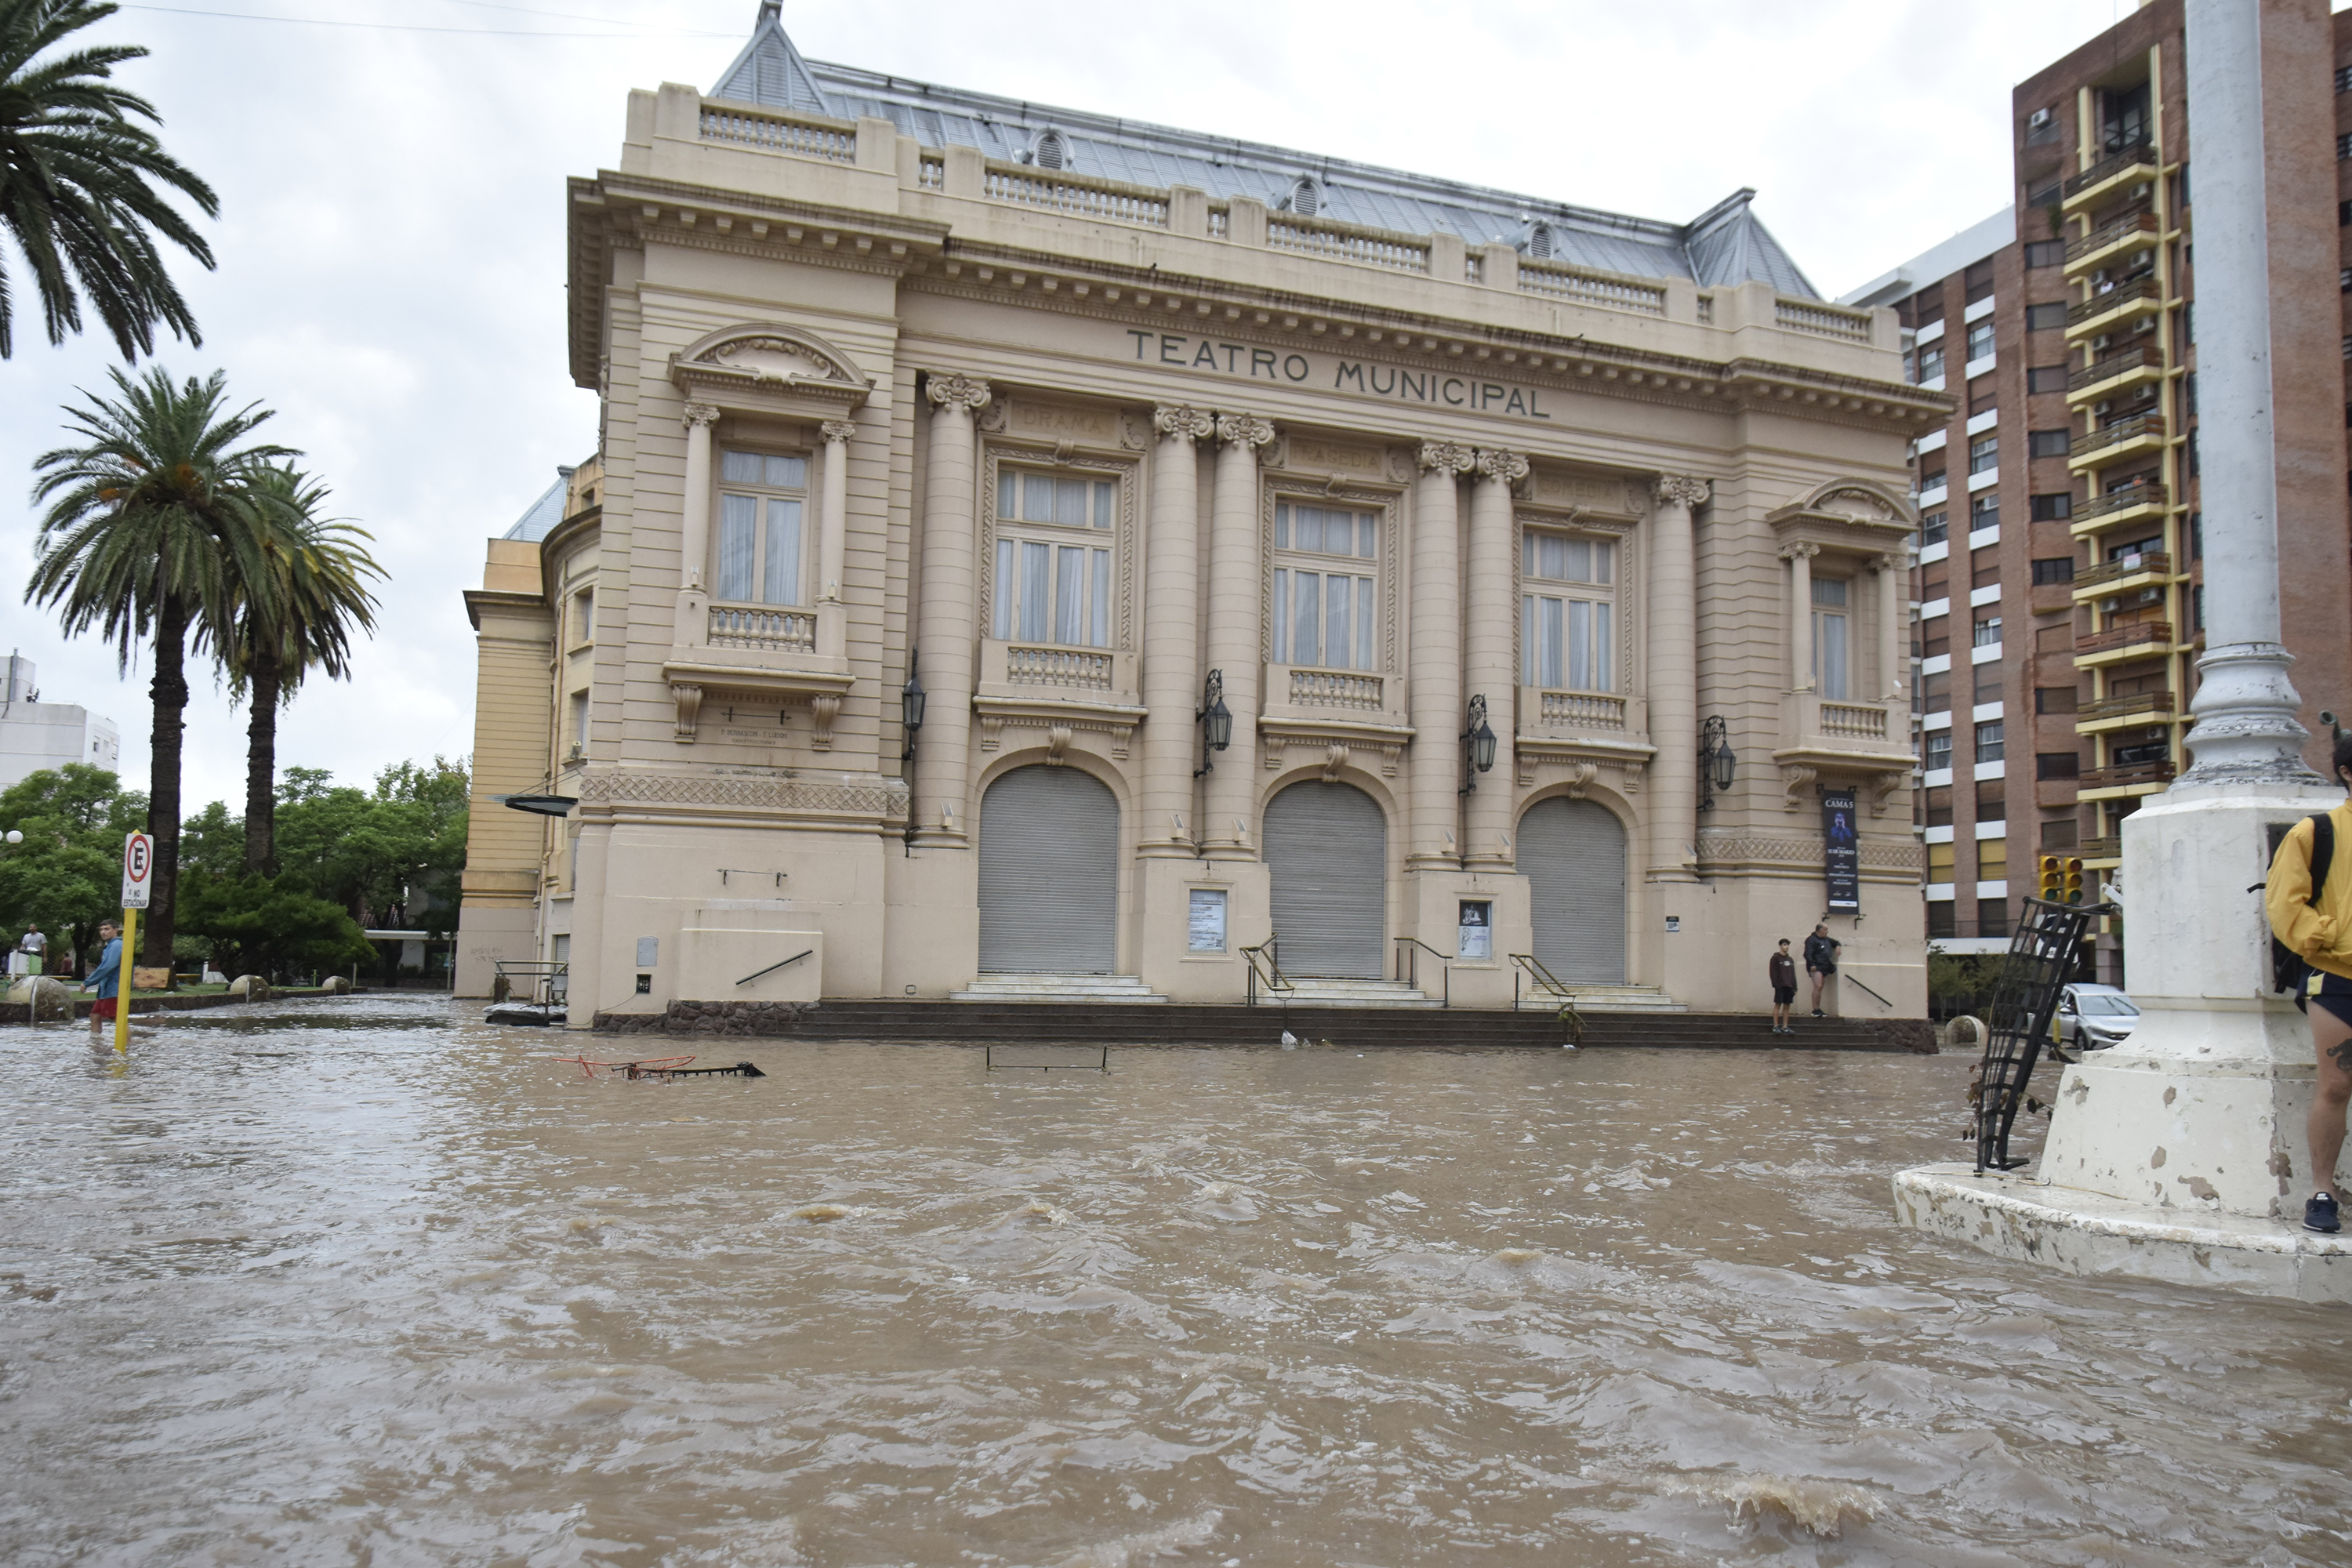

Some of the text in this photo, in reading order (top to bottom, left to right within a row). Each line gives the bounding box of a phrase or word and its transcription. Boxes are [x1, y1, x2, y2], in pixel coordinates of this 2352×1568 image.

[1127, 329, 1550, 418] TEATRO MUNICIPAL
[1023, 408, 1103, 434] DRAMA
[1290, 442, 1381, 470] TRAGEDIA
[1540, 477, 1614, 500] COMEDIA
[1825, 799, 1849, 808] CAMA
[133, 847, 144, 869] E
[124, 898, 147, 907] ESTACIONAR
[133, 889, 141, 898] NO
